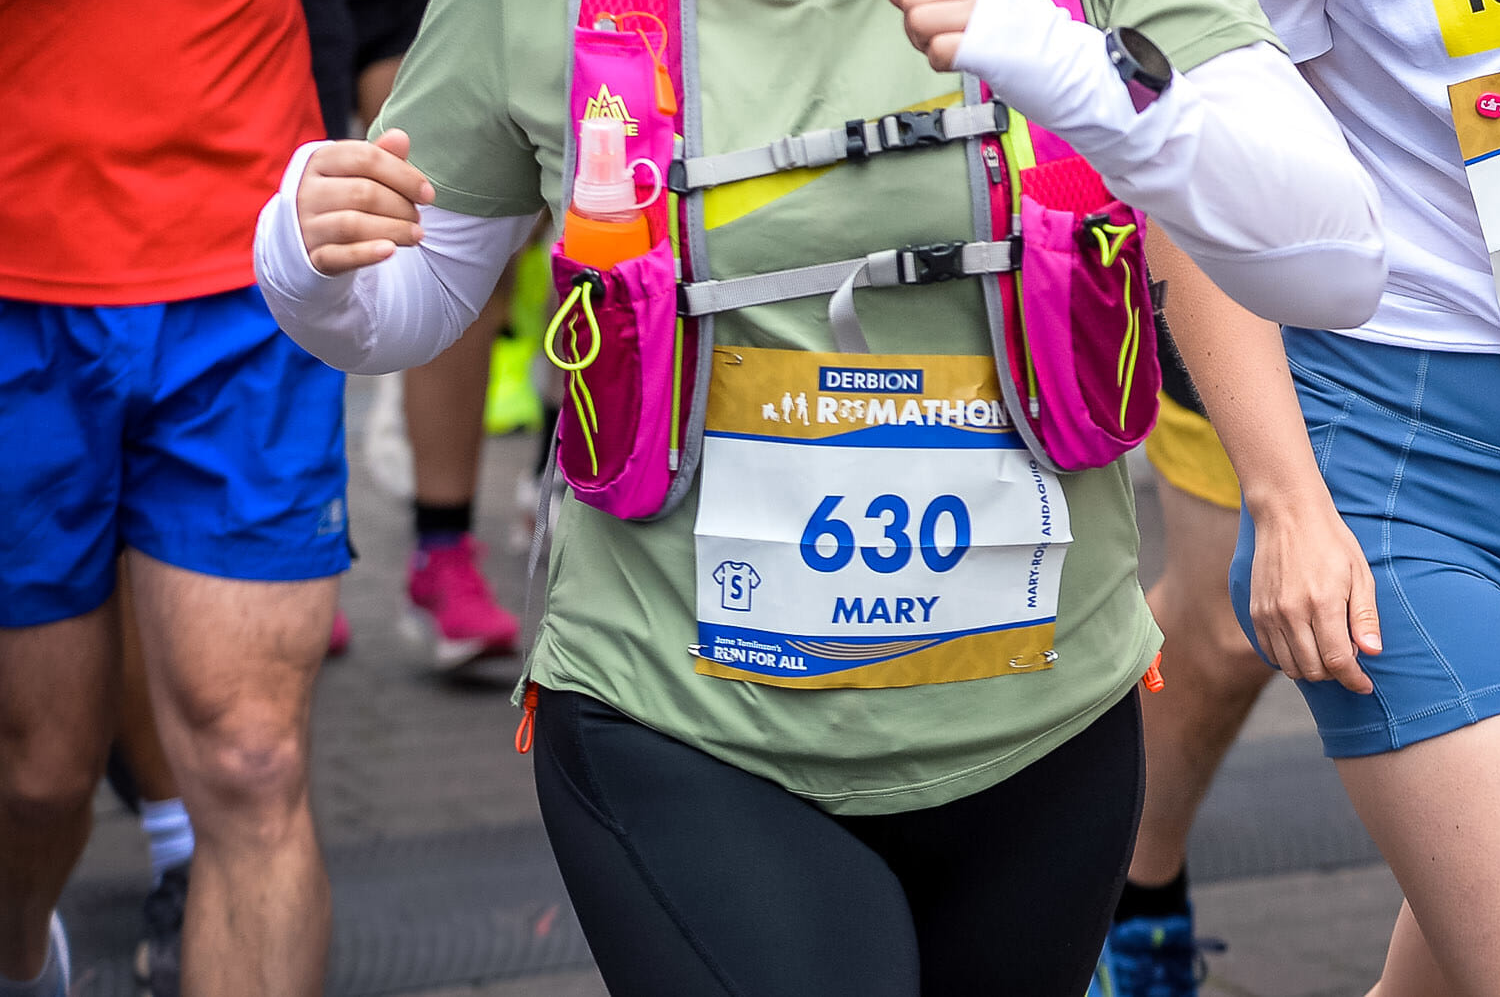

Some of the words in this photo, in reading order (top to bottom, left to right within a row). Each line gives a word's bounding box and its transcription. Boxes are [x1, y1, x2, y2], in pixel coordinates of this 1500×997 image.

[826, 370, 919, 391] DERBION
[800, 493, 972, 575] 630
[731, 575, 743, 600] S
[831, 595, 941, 625] MARY
[713, 635, 736, 645] Jane
[736, 637, 783, 653] Tomlinson's
[713, 645, 746, 663] RUN
[747, 649, 776, 667] FOR
[777, 655, 808, 670] ALL
